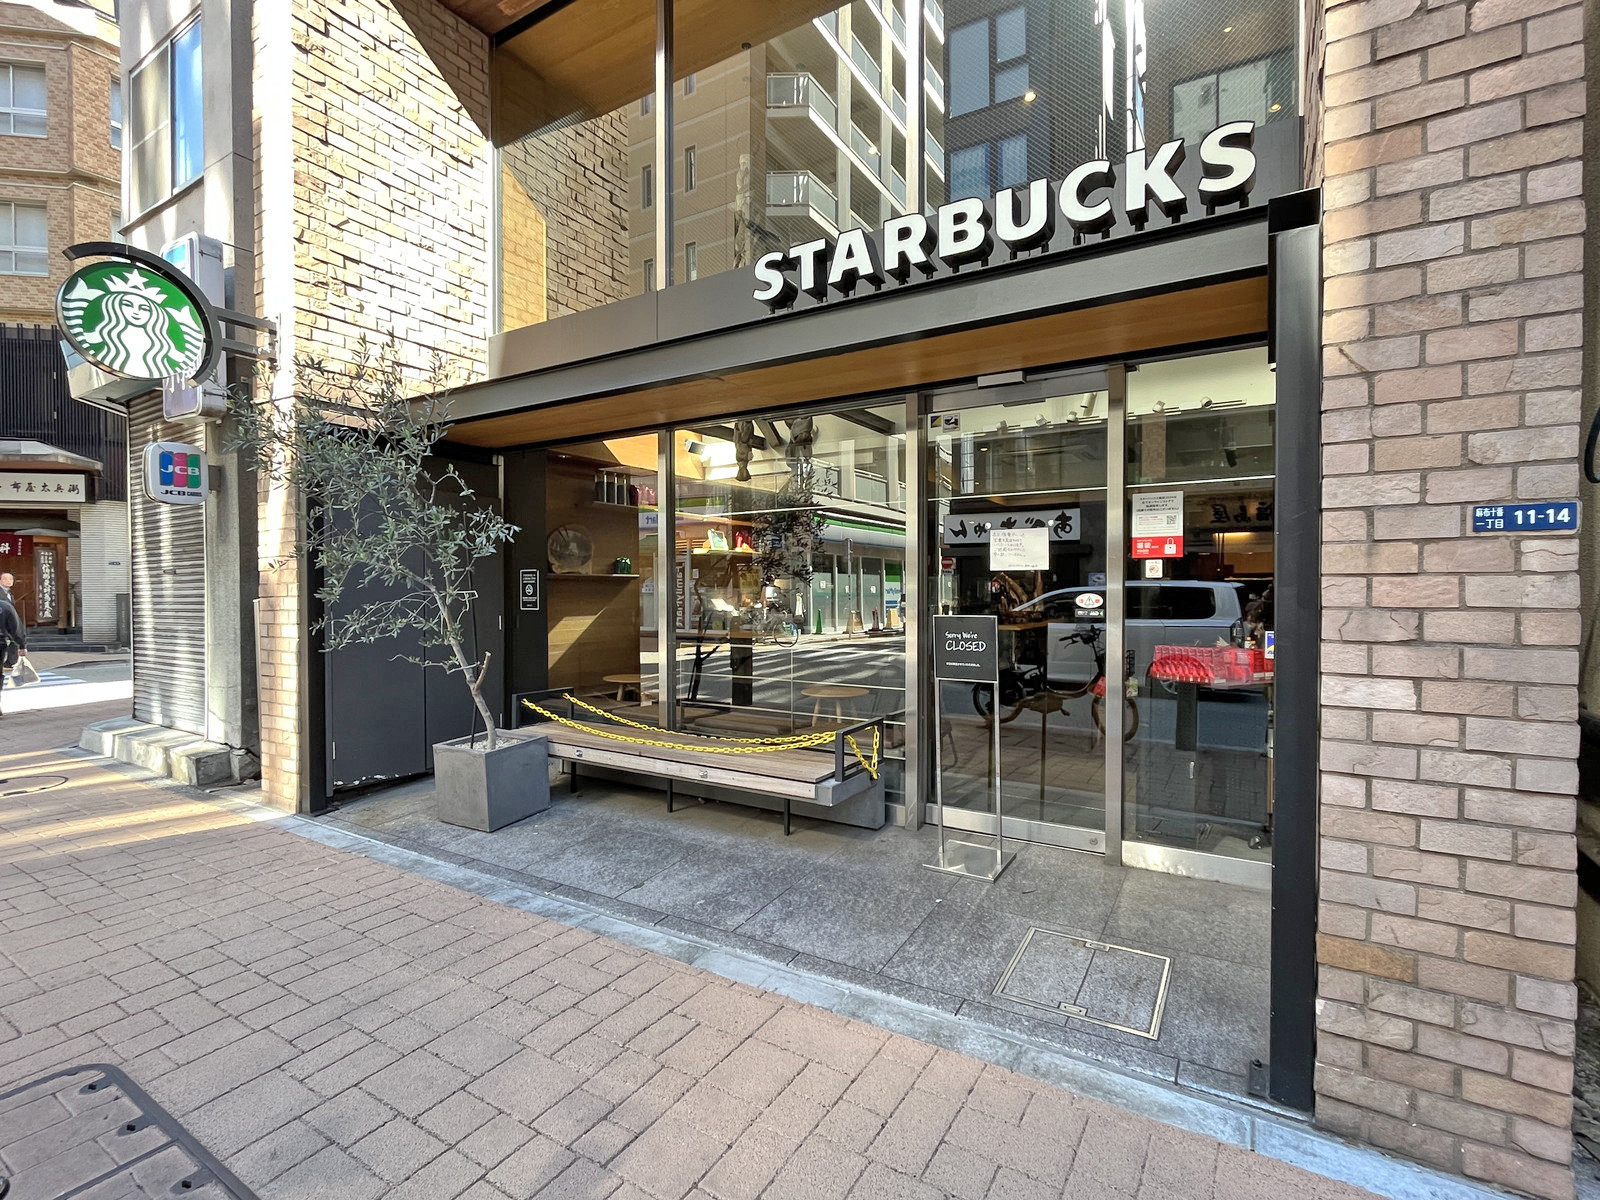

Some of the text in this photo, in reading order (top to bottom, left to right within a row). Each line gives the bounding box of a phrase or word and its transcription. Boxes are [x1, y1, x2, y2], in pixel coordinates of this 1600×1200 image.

[752, 119, 1256, 302] STARBUCKS
[161, 464, 200, 476] JCB
[1475, 507, 1504, 518] 麻布十番
[1514, 507, 1571, 525] 11-14
[1475, 518, 1504, 529] 一丁目
[945, 631, 962, 640] Sorry
[945, 640, 986, 652] CLOSED
